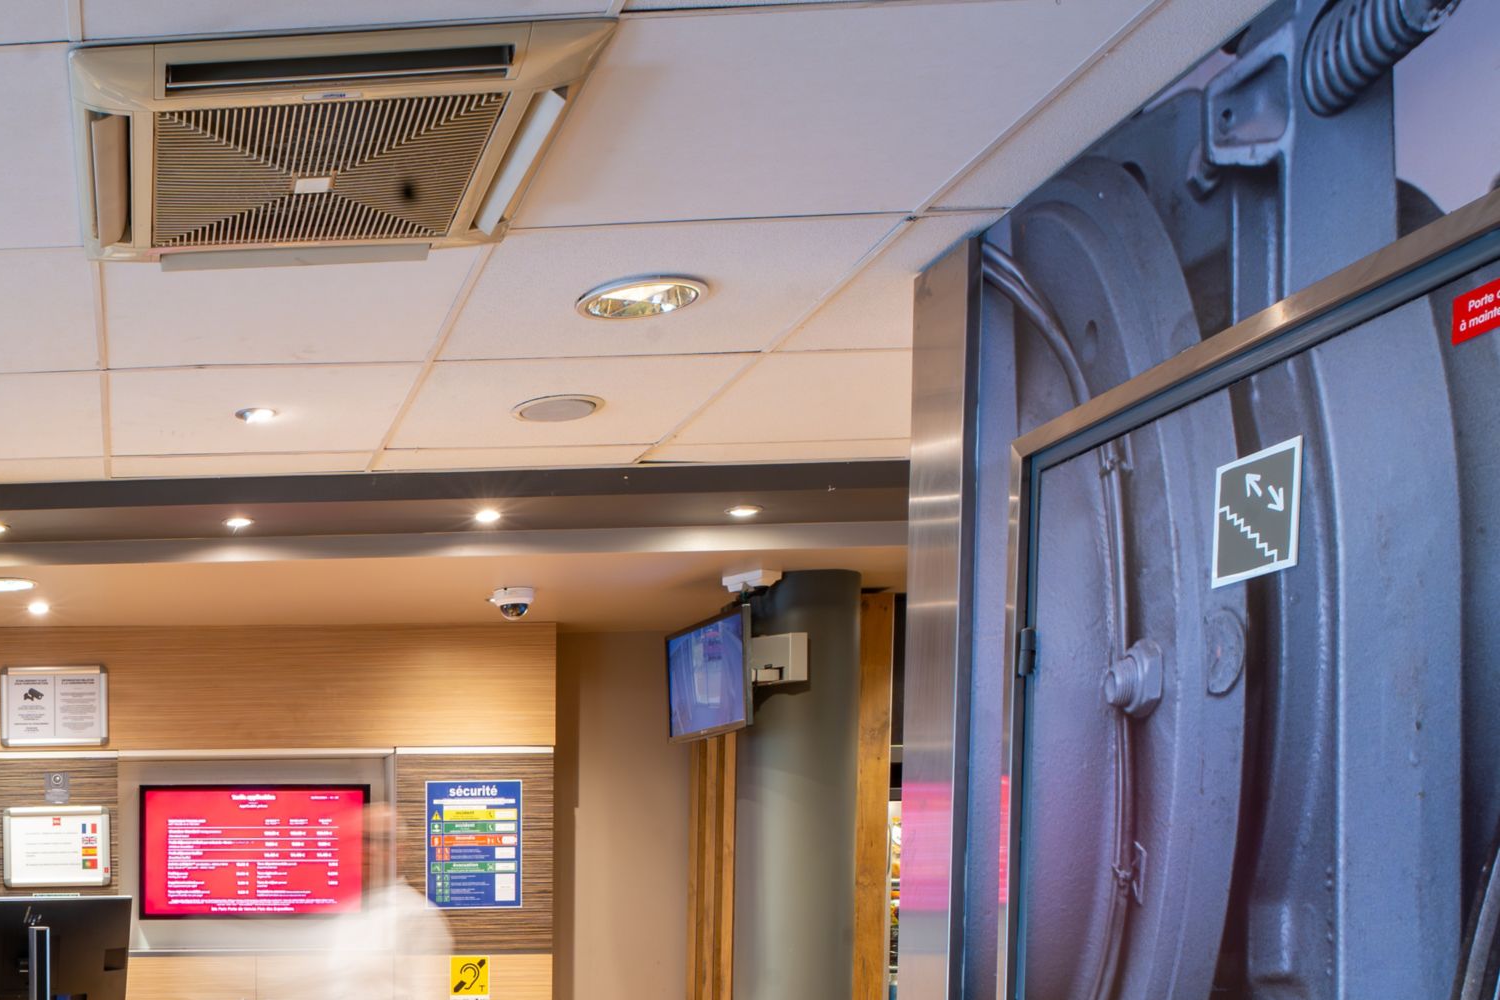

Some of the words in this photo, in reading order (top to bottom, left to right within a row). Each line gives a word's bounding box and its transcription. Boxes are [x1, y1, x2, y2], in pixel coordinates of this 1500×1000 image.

[1468, 293, 1494, 312] Porte
[1460, 320, 1466, 331] à
[449, 785, 498, 797] sécurité
